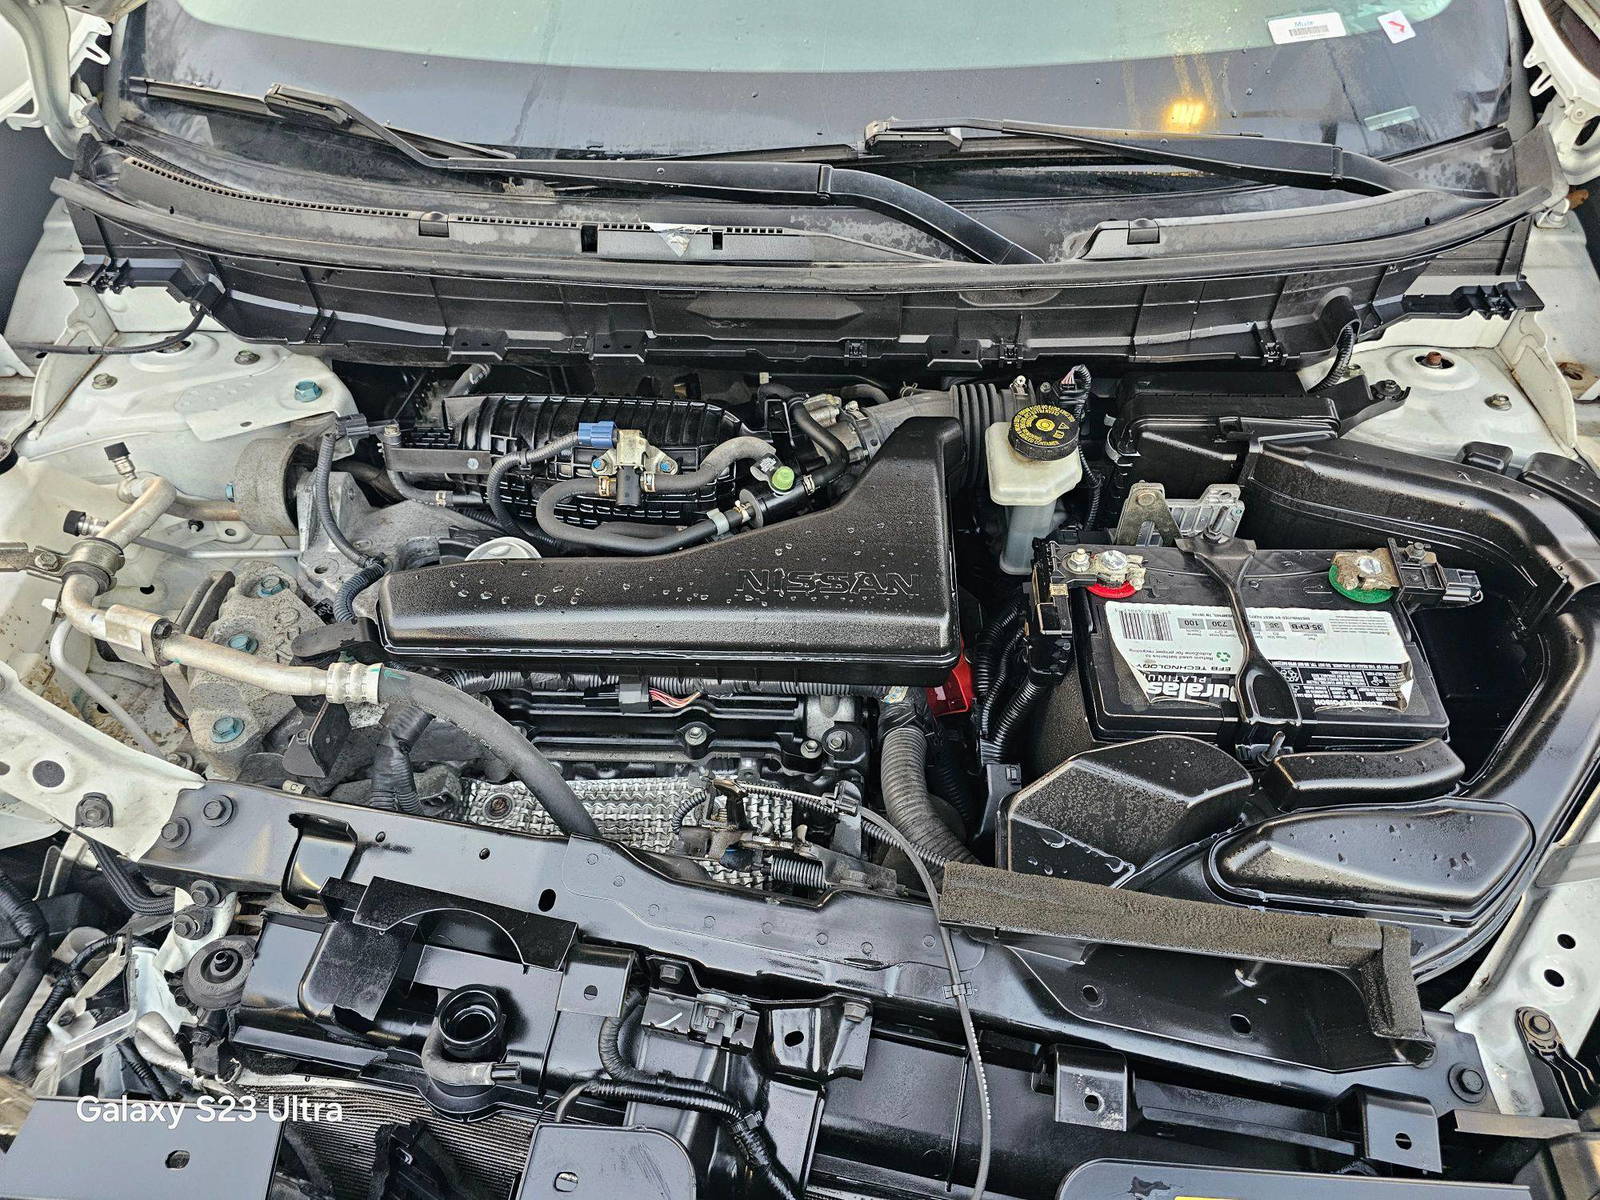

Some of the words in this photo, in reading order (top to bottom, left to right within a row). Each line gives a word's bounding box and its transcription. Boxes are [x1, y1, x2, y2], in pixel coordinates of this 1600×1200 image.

[736, 568, 920, 597] NISSAN
[1143, 674, 1206, 683] PLATINU
[1147, 682, 1237, 702] uralas
